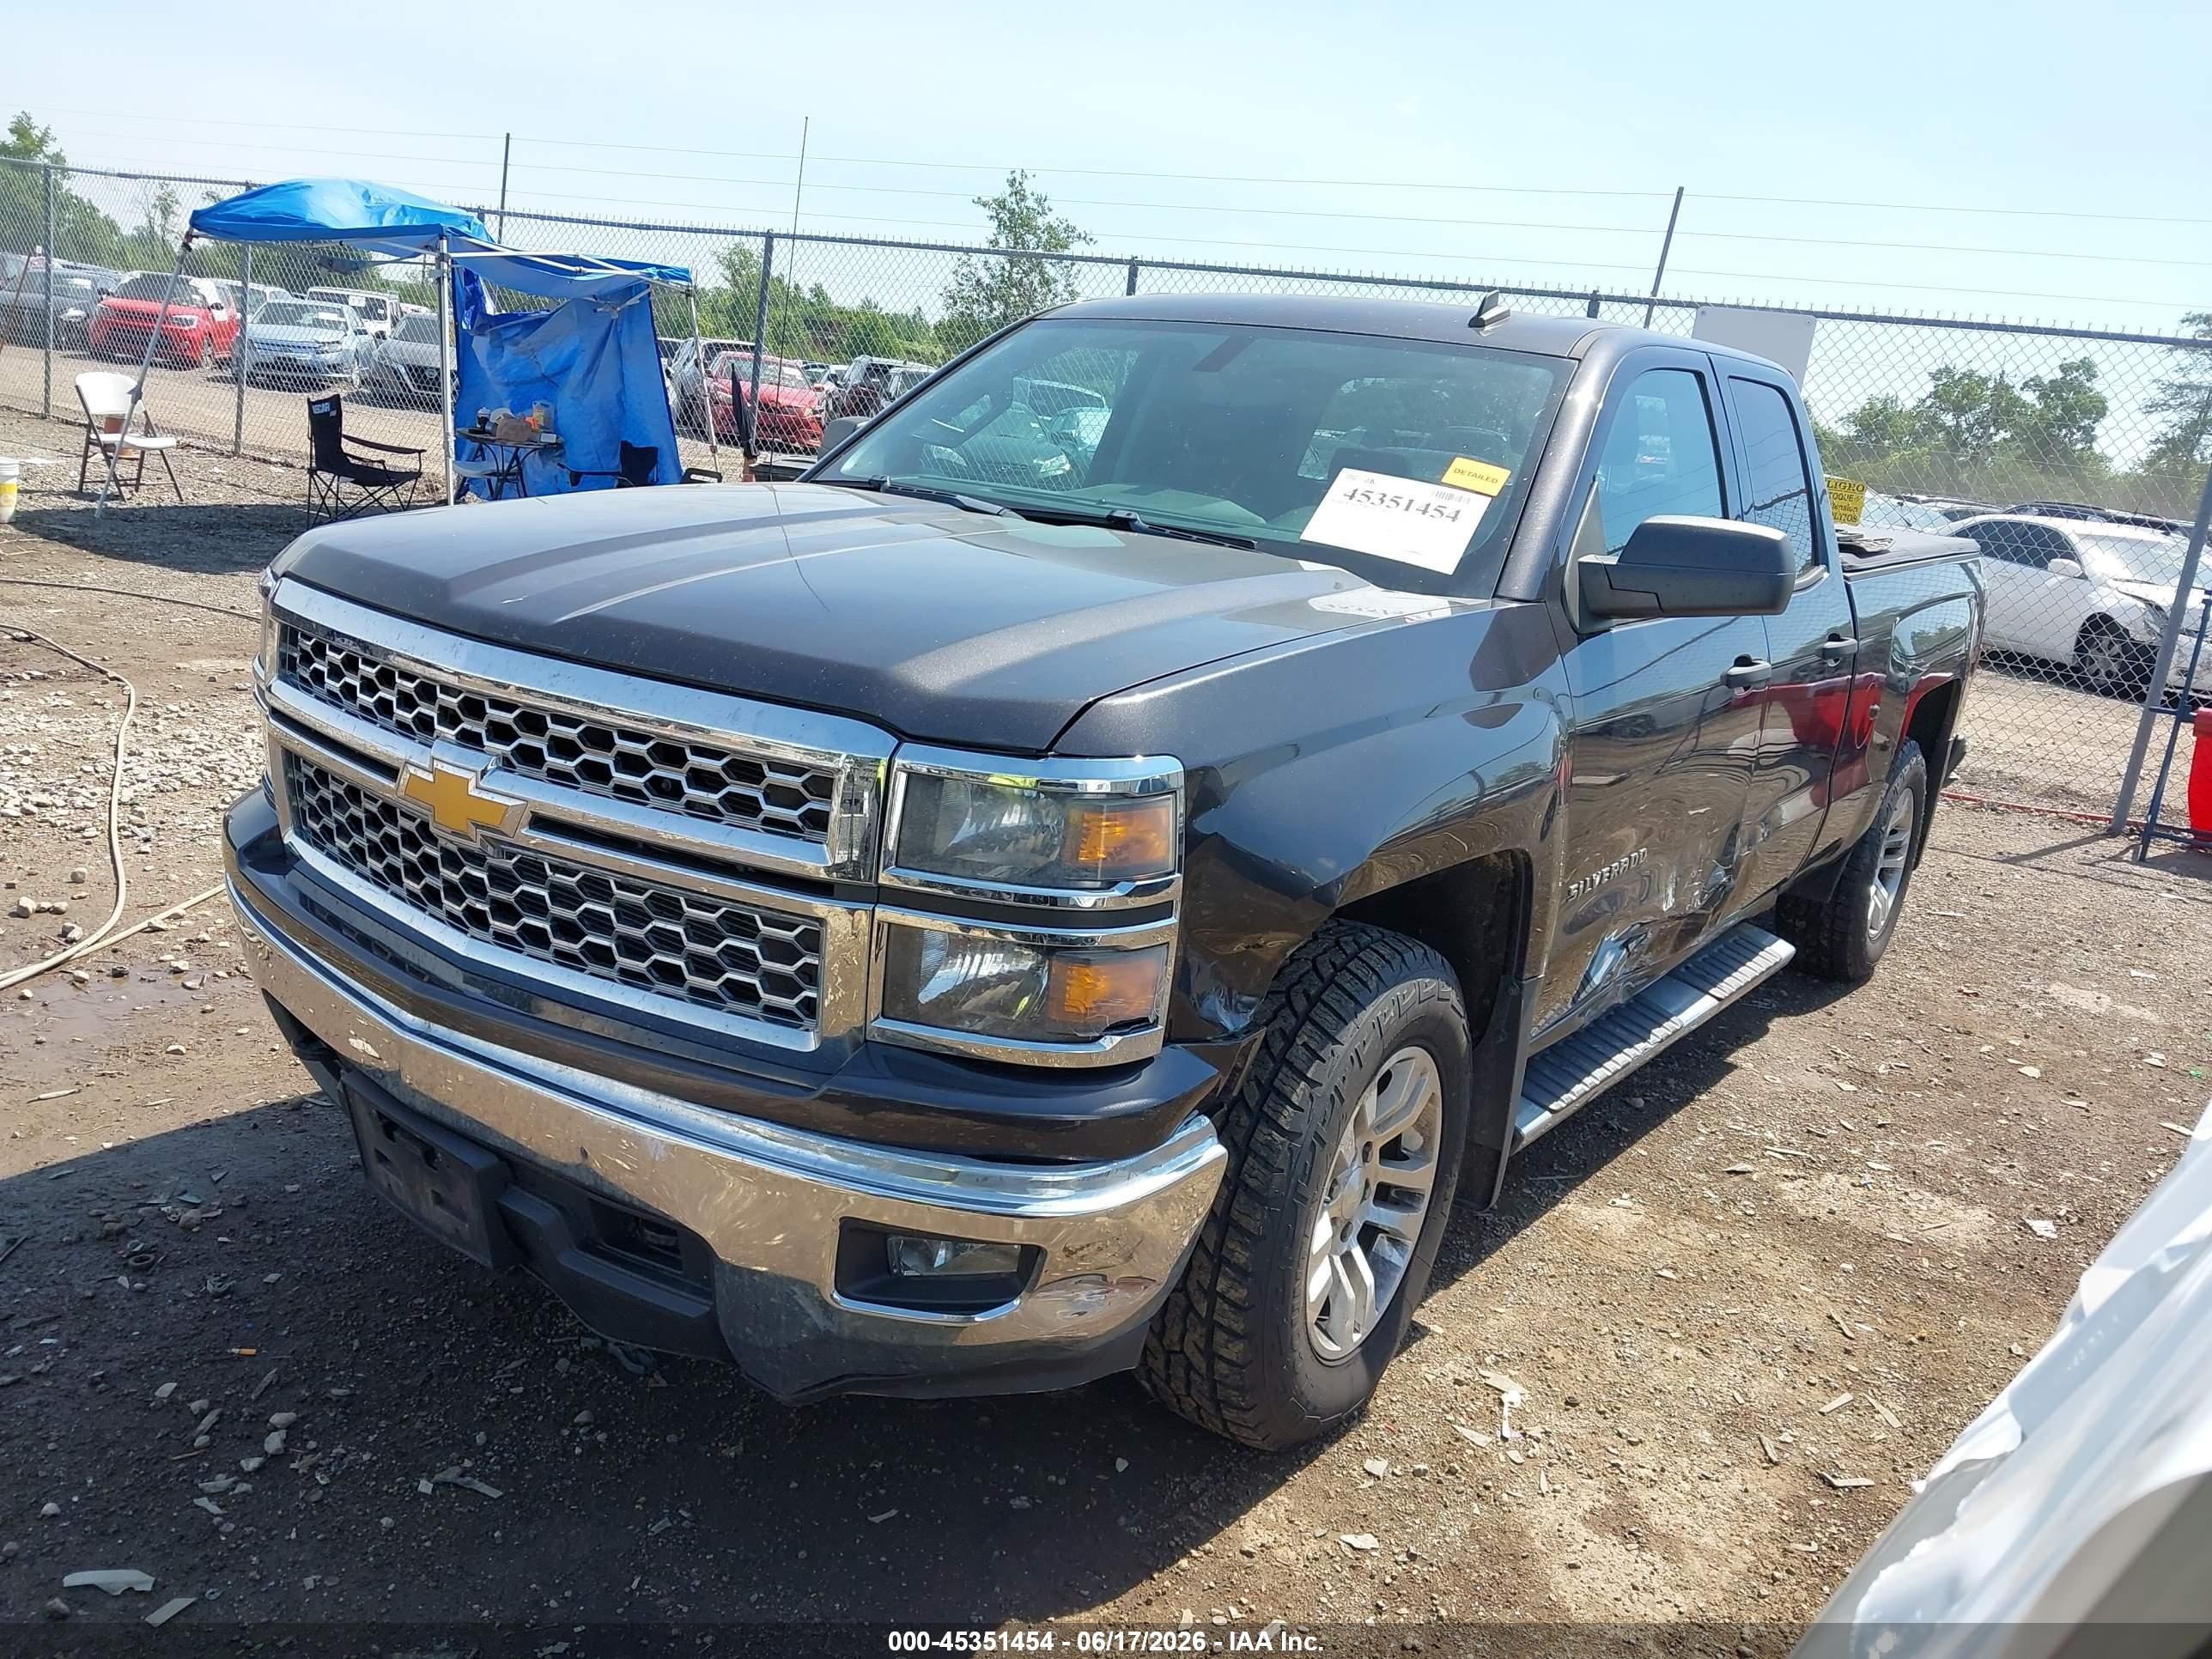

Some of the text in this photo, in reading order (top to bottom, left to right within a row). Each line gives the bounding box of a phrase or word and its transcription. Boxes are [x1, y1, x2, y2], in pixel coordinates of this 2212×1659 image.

[1453, 467, 1498, 483] DETAILED
[1342, 487, 1461, 522] 45351454
[1565, 847, 1648, 902] SILVERADO
